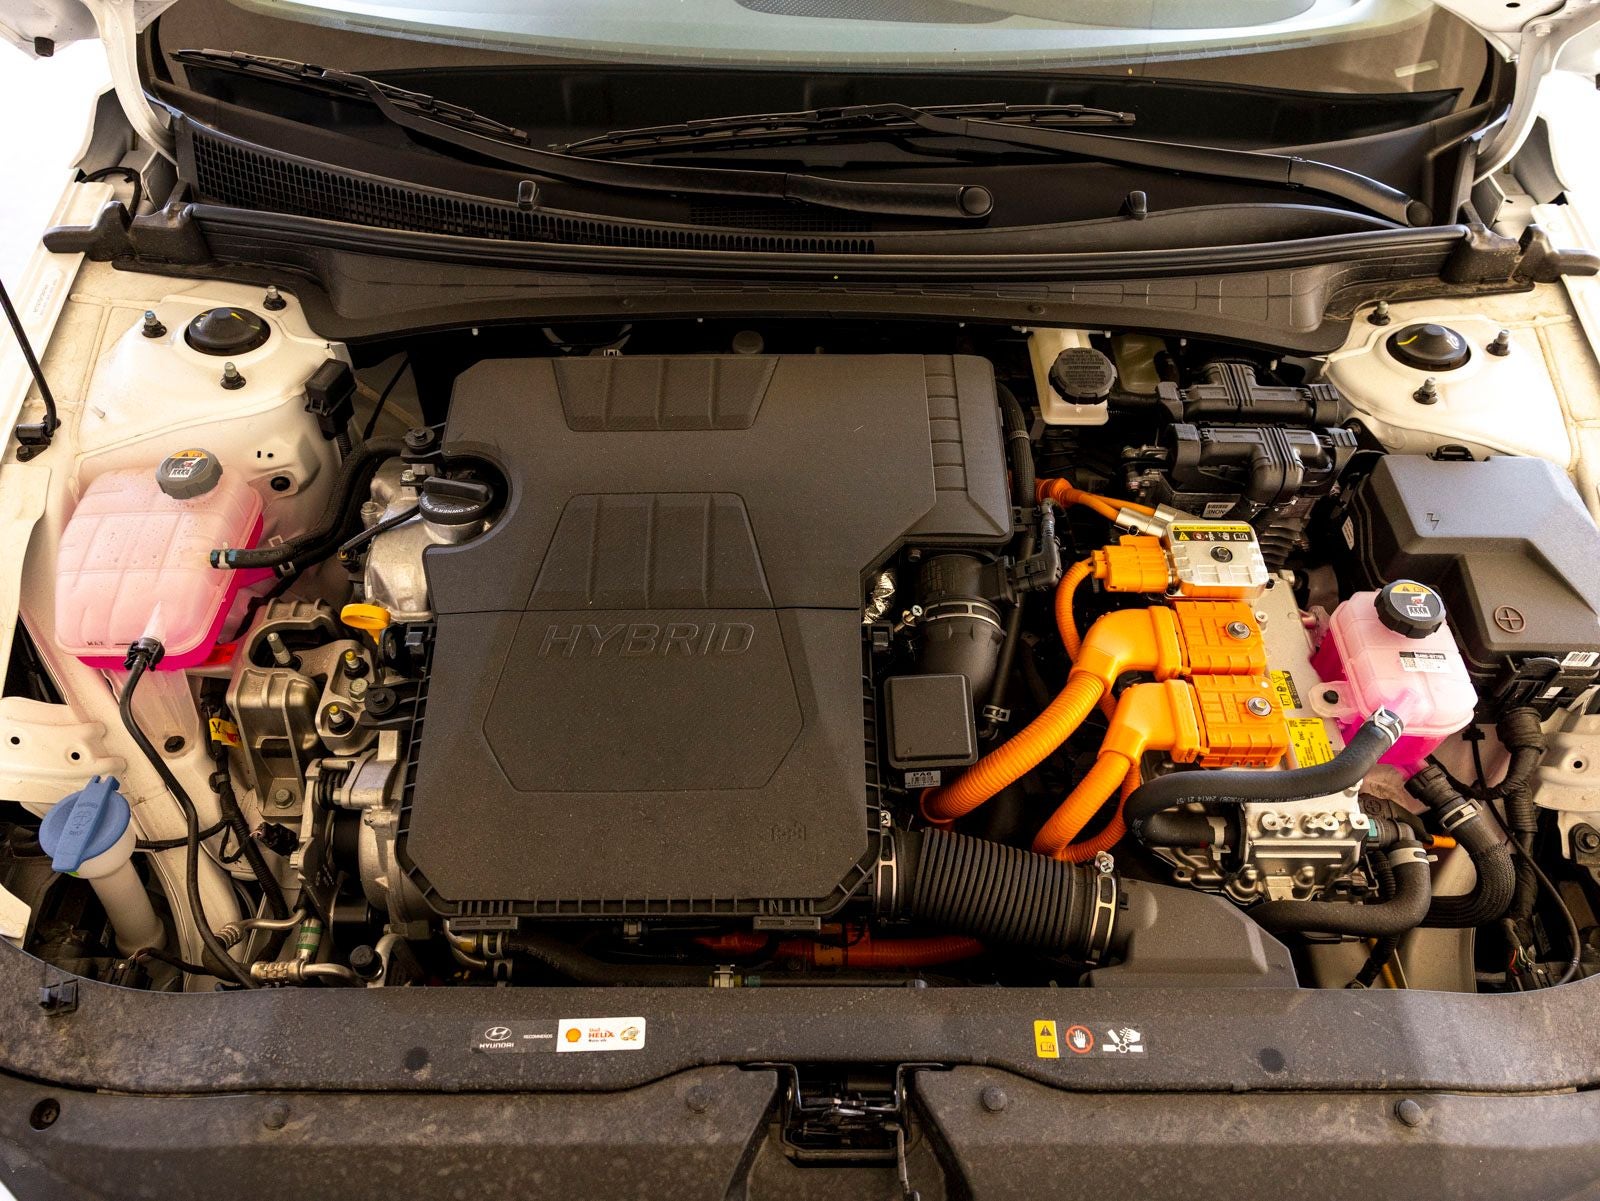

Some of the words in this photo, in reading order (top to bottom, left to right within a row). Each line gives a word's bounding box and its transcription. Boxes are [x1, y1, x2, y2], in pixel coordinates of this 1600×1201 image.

[537, 622, 755, 657] HYBRID
[588, 1031, 615, 1039] HELIX
[479, 1042, 515, 1050] HYUNDAI
